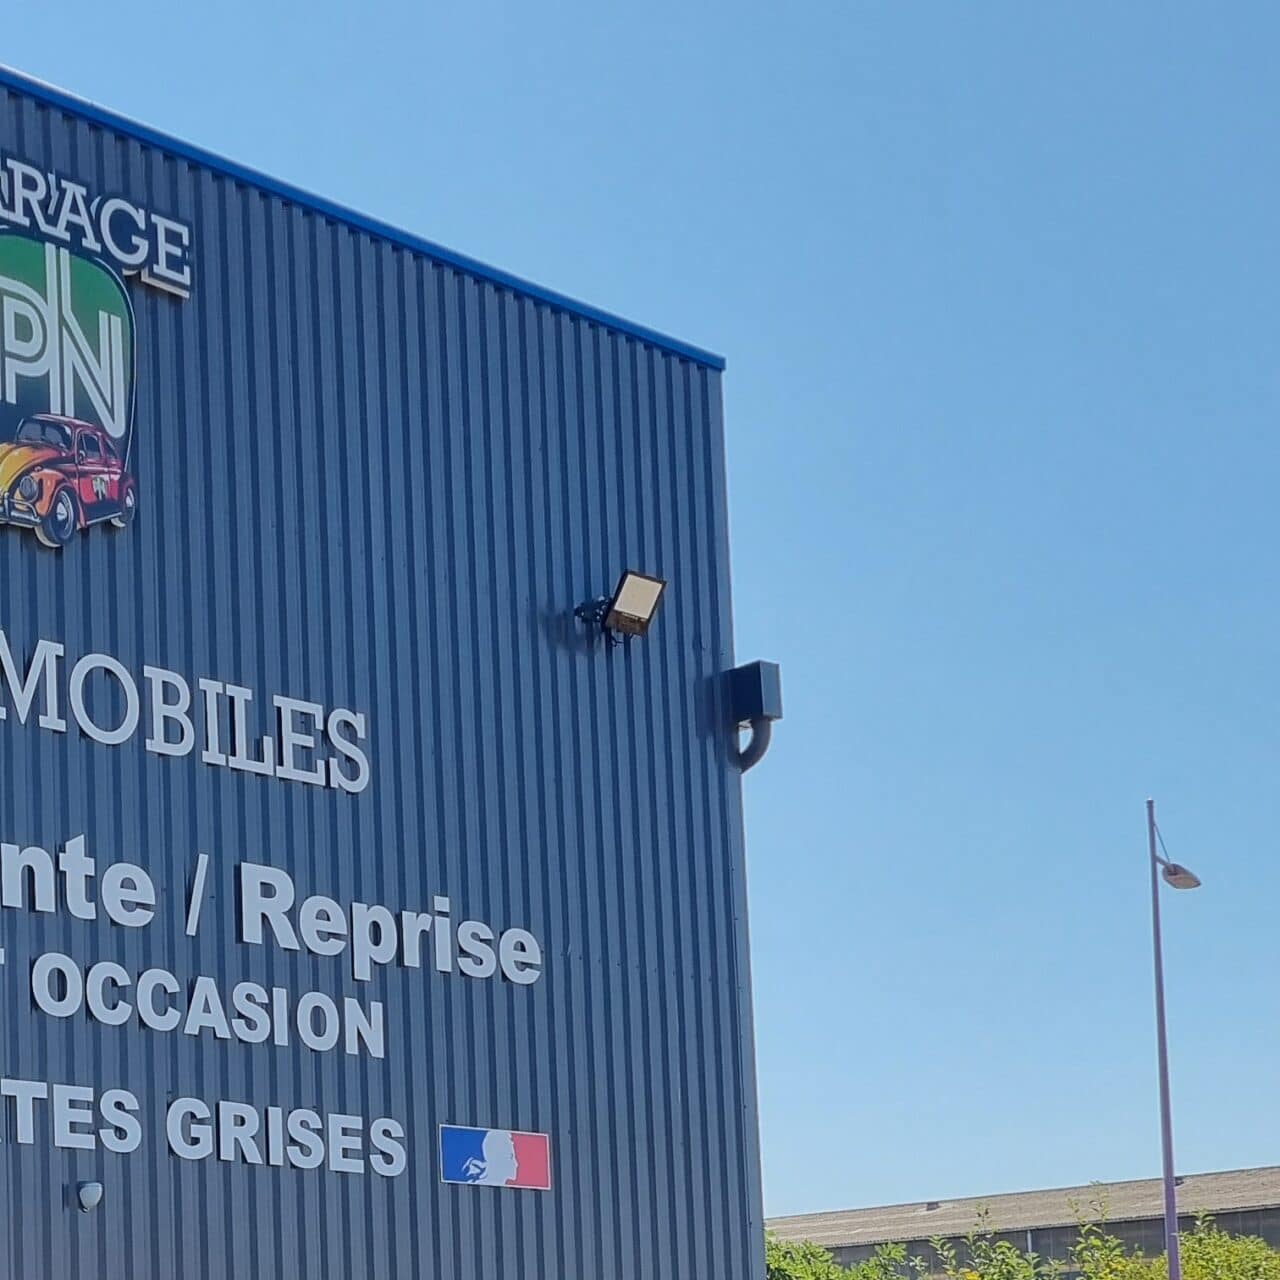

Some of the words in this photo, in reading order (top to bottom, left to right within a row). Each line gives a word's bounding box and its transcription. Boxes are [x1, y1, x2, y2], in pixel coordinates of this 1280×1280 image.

[185, 853, 209, 936] /
[241, 861, 543, 985] Reprise
[32, 952, 385, 1059] OCCASION
[166, 1097, 408, 1178] GRISES
